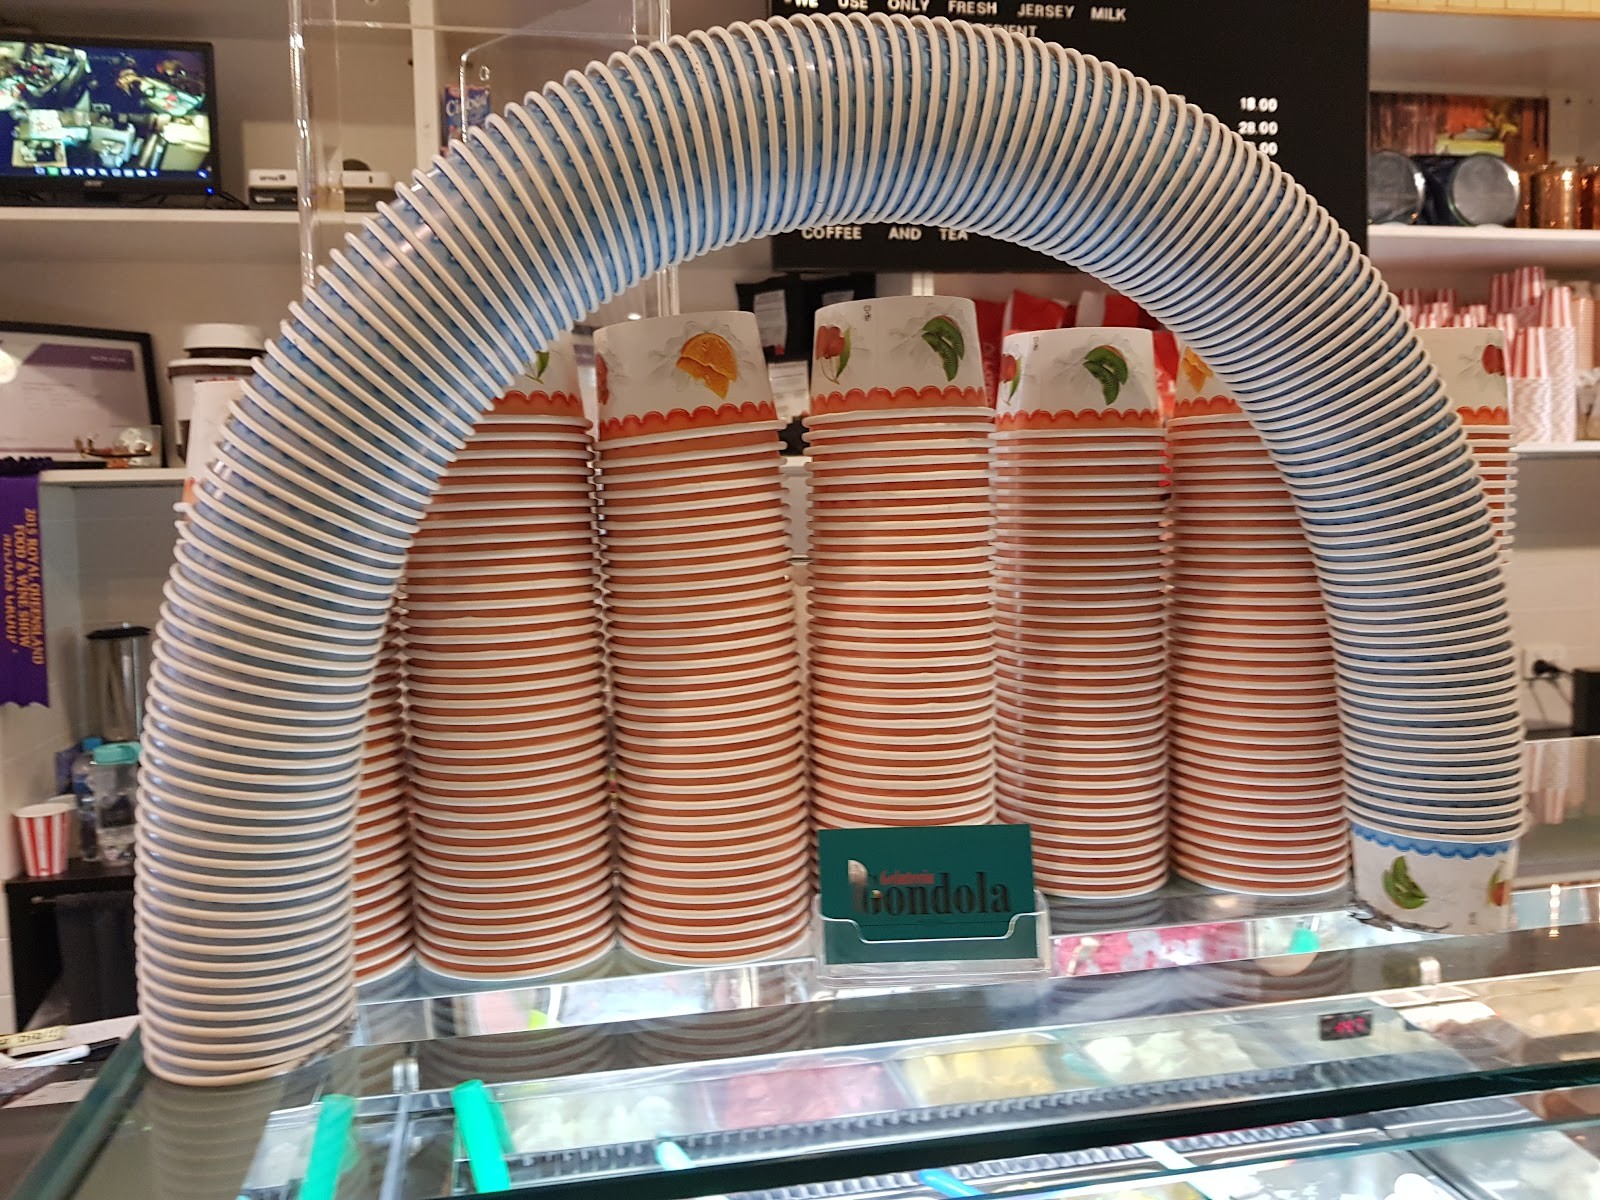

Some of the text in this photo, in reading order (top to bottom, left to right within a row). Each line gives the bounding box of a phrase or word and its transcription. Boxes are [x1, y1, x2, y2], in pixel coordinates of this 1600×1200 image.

[837, 0, 869, 10] USE
[887, 0, 930, 12] ONLY
[948, 0, 998, 15] FRESH
[1016, 3, 1075, 19] JERSEY
[1090, 6, 1127, 21] MILK
[801, 226, 969, 241] COFFEE AND TEA
